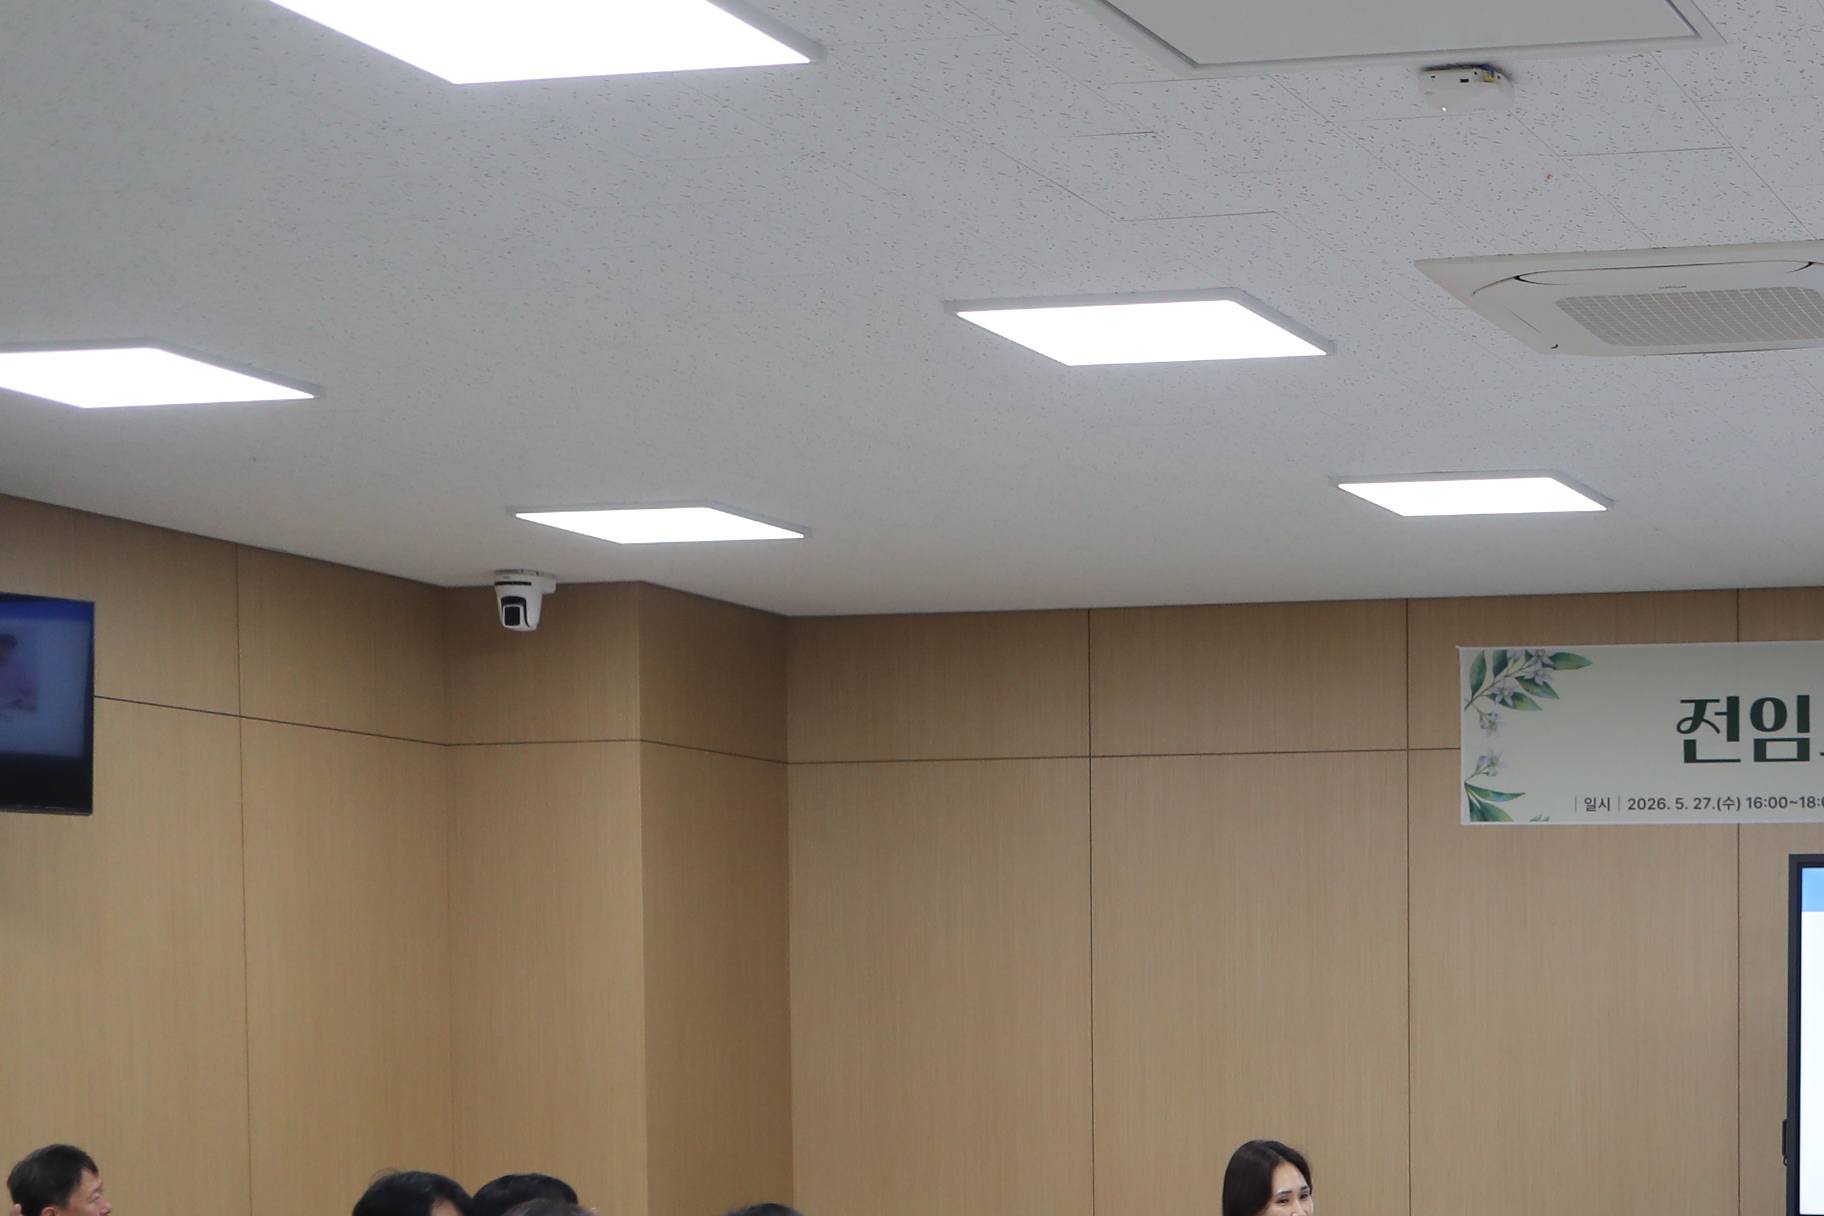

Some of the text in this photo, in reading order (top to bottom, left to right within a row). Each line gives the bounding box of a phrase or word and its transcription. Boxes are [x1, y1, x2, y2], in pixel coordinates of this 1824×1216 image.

[1583, 795, 1611, 813] 일시
[1627, 796, 1671, 811] 2026.
[1674, 796, 1689, 811] 5.
[1692, 795, 1741, 812] 27.(수)
